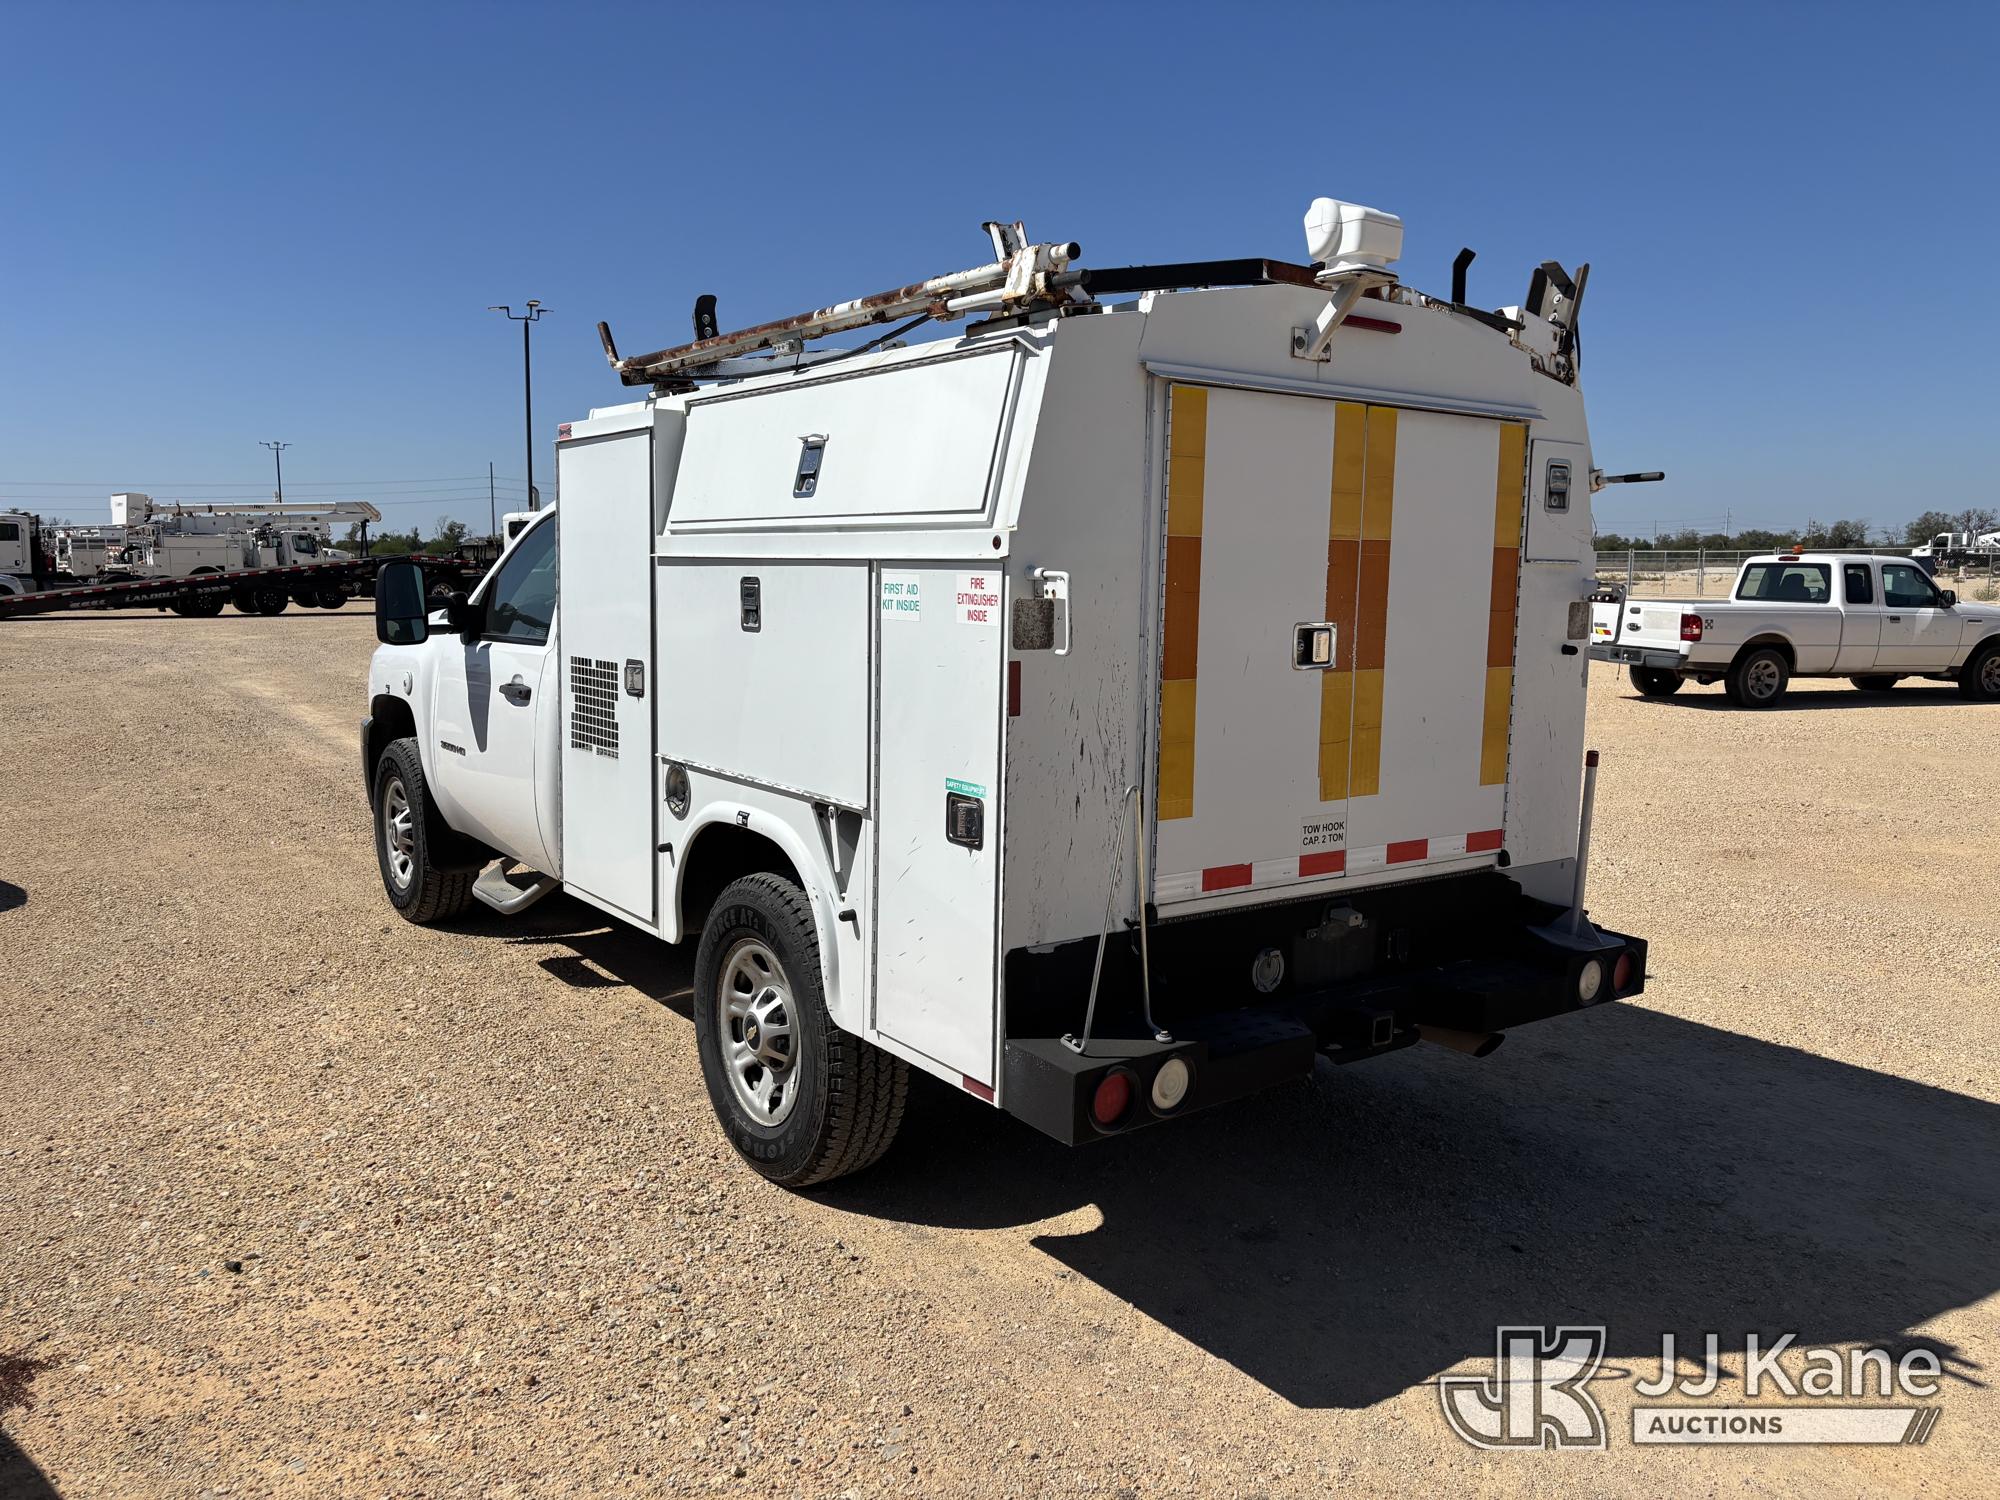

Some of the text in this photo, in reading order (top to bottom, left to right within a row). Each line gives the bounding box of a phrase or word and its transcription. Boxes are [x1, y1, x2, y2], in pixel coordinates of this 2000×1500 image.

[883, 583, 919, 596] FIRST AID
[970, 577, 984, 590] FIRE
[882, 599, 920, 612] KIT INSIDE
[957, 593, 998, 607] EXTINGUISHER
[967, 609, 988, 622] INSIDE
[1302, 821, 1344, 834] TOW HOOK
[1302, 833, 1344, 846] CAP. 2 TON
